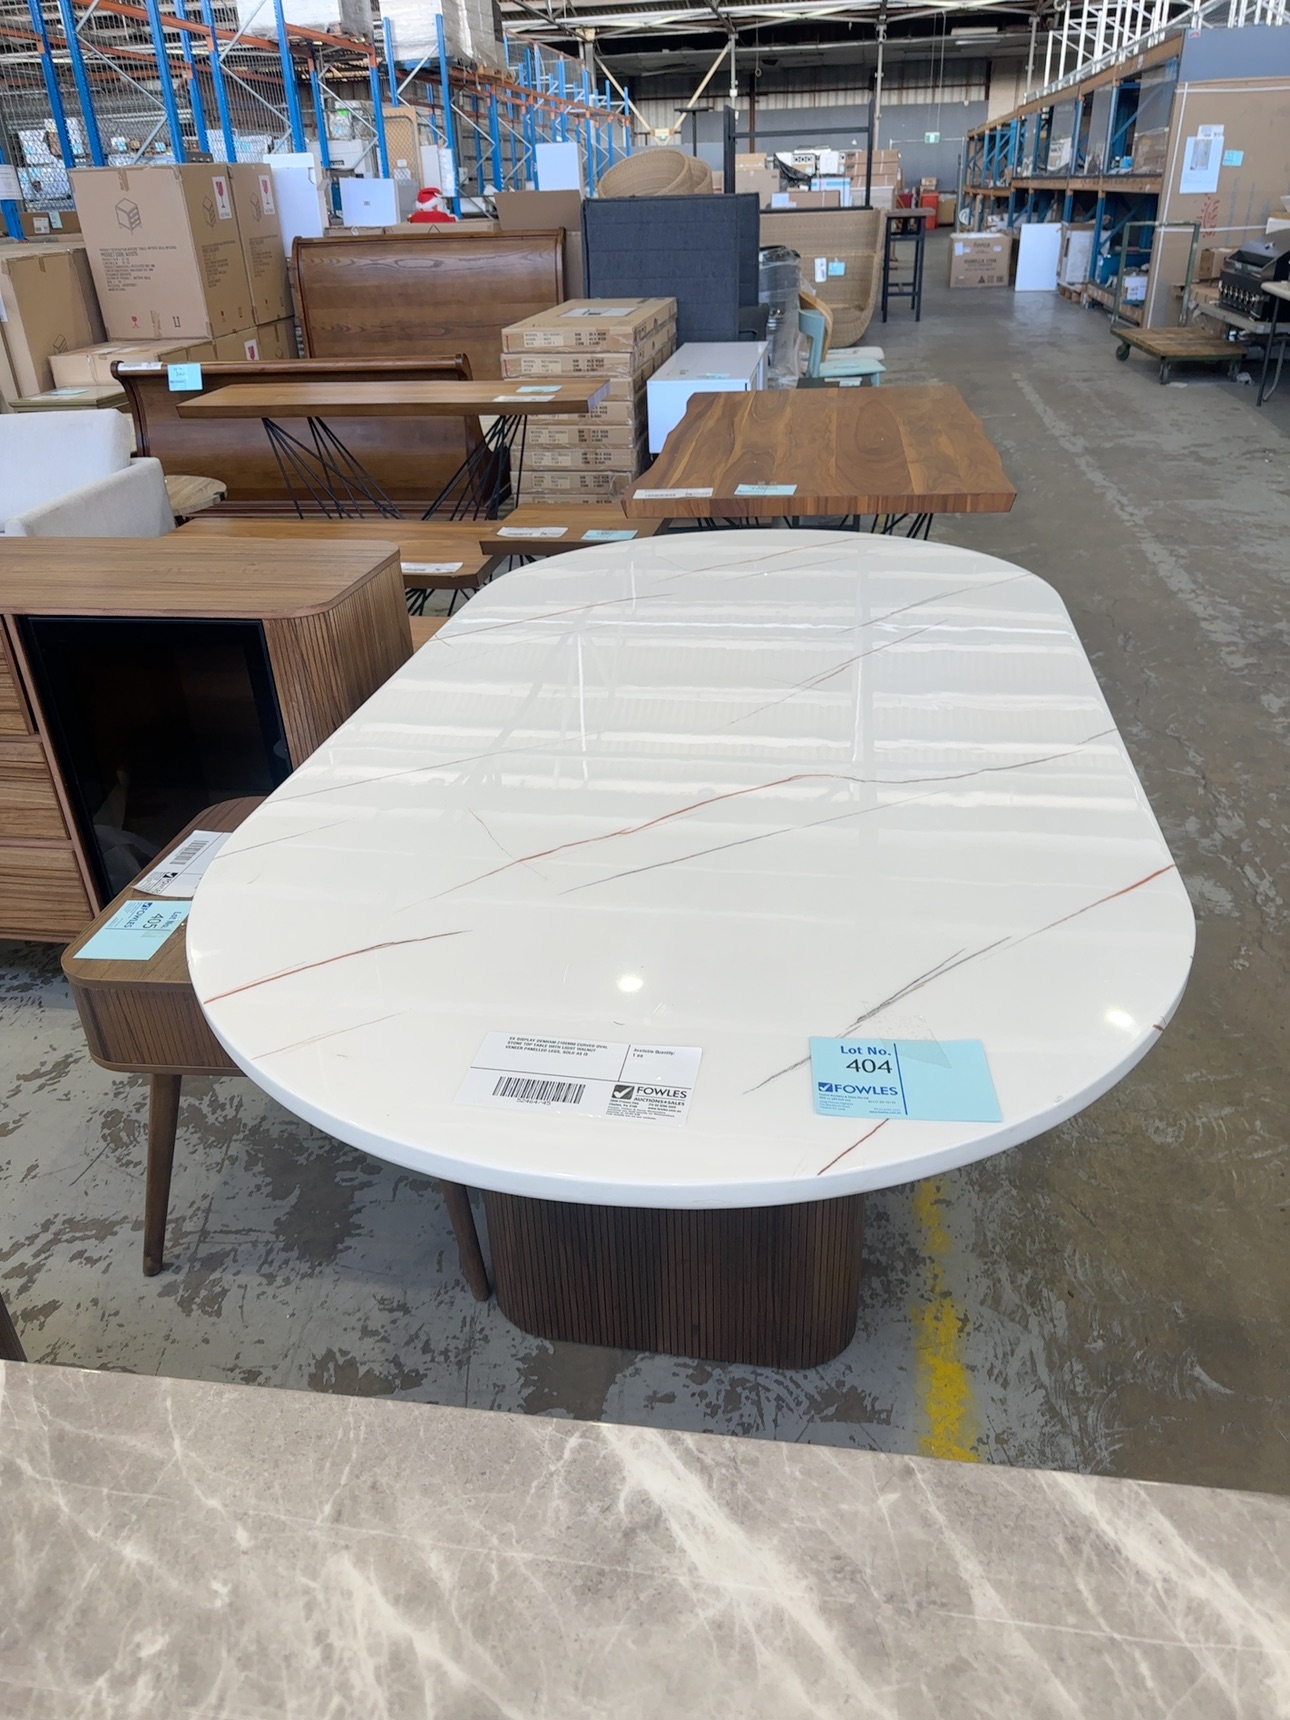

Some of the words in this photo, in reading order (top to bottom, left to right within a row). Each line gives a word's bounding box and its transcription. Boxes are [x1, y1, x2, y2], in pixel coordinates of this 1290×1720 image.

[143, 913, 164, 929] 405
[840, 1045, 863, 1056] Lot
[867, 1046, 891, 1056] No.
[846, 1059, 892, 1074] 404
[636, 1086, 687, 1098] FOWLES
[834, 1084, 898, 1095] FOWLES
